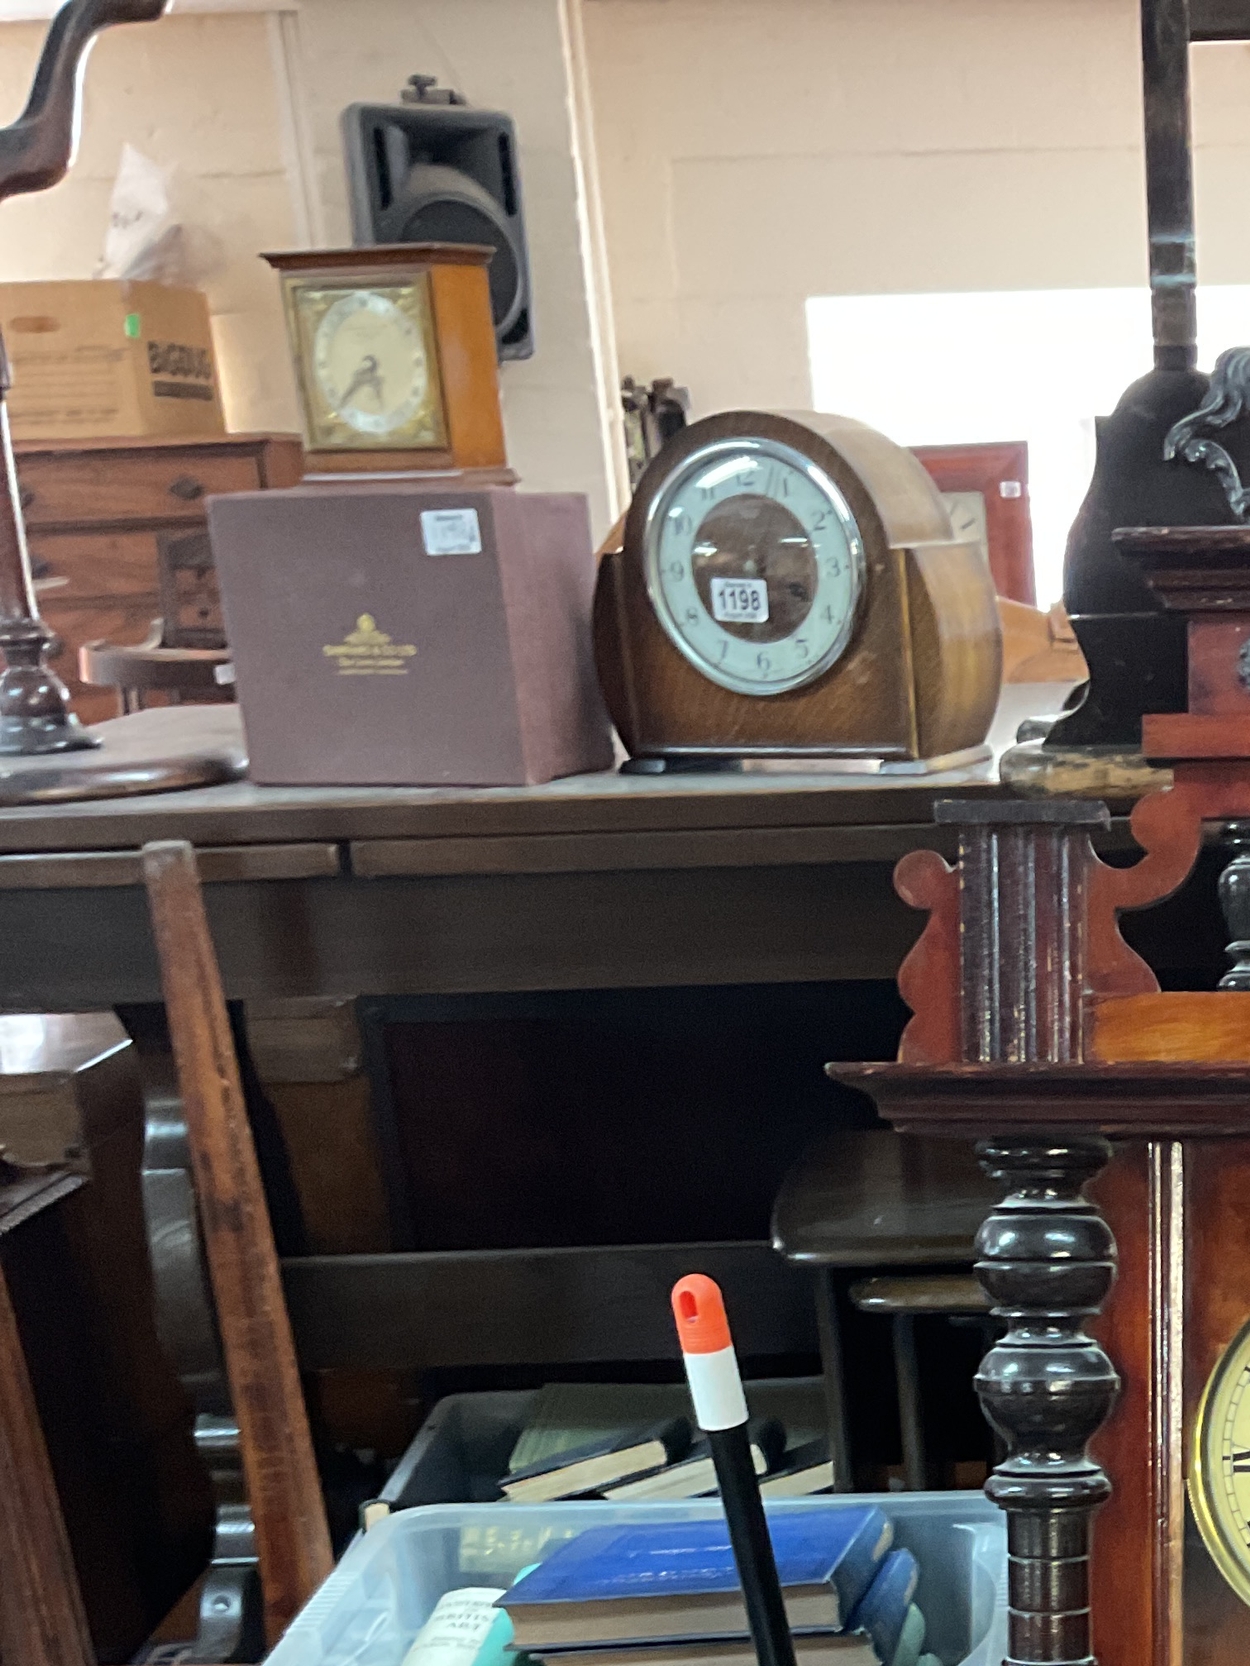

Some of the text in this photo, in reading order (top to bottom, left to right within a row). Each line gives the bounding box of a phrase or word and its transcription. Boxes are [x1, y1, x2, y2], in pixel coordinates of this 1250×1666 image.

[813, 510, 827, 531] 2
[669, 560, 684, 582] 9
[826, 557, 841, 578] 3
[719, 589, 761, 611] 1198
[820, 604, 835, 624] 4
[717, 639, 728, 660] 7
[796, 638, 809, 659] 5
[757, 652, 771, 672] 6
